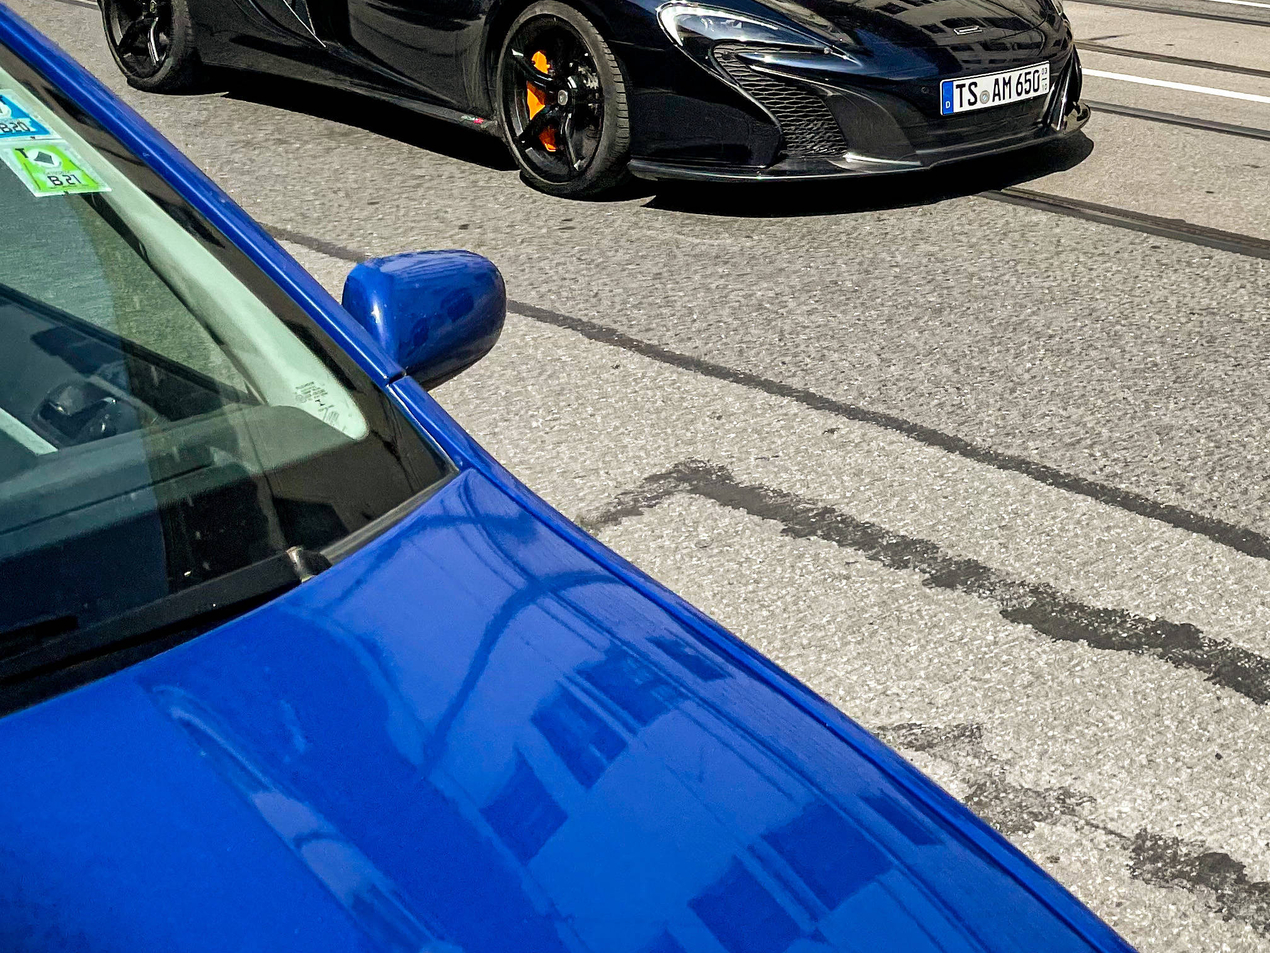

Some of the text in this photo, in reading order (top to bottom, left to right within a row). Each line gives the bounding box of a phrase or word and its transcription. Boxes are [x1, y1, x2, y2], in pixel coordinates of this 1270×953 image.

[955, 69, 1040, 108] TS AM 650
